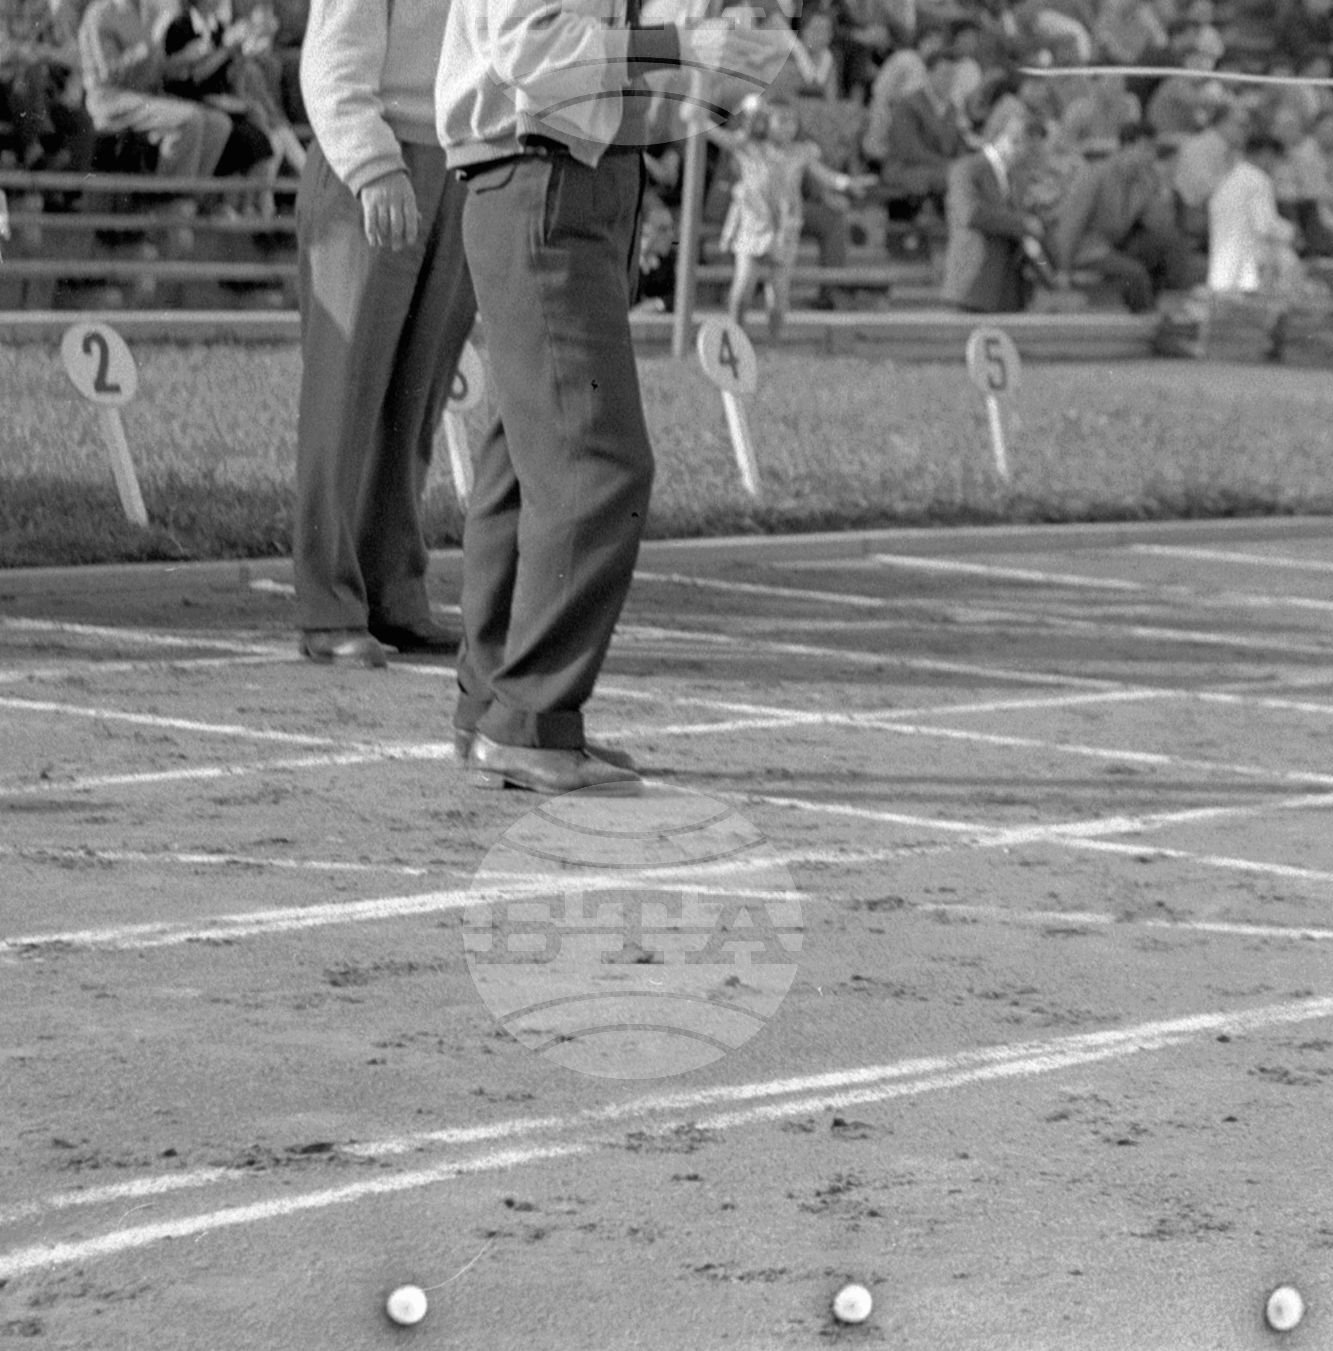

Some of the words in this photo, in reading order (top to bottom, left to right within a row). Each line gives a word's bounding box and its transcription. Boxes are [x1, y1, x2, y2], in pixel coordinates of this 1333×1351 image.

[82, 332, 121, 393] 2
[719, 330, 739, 380] 4
[983, 336, 1007, 390] 5
